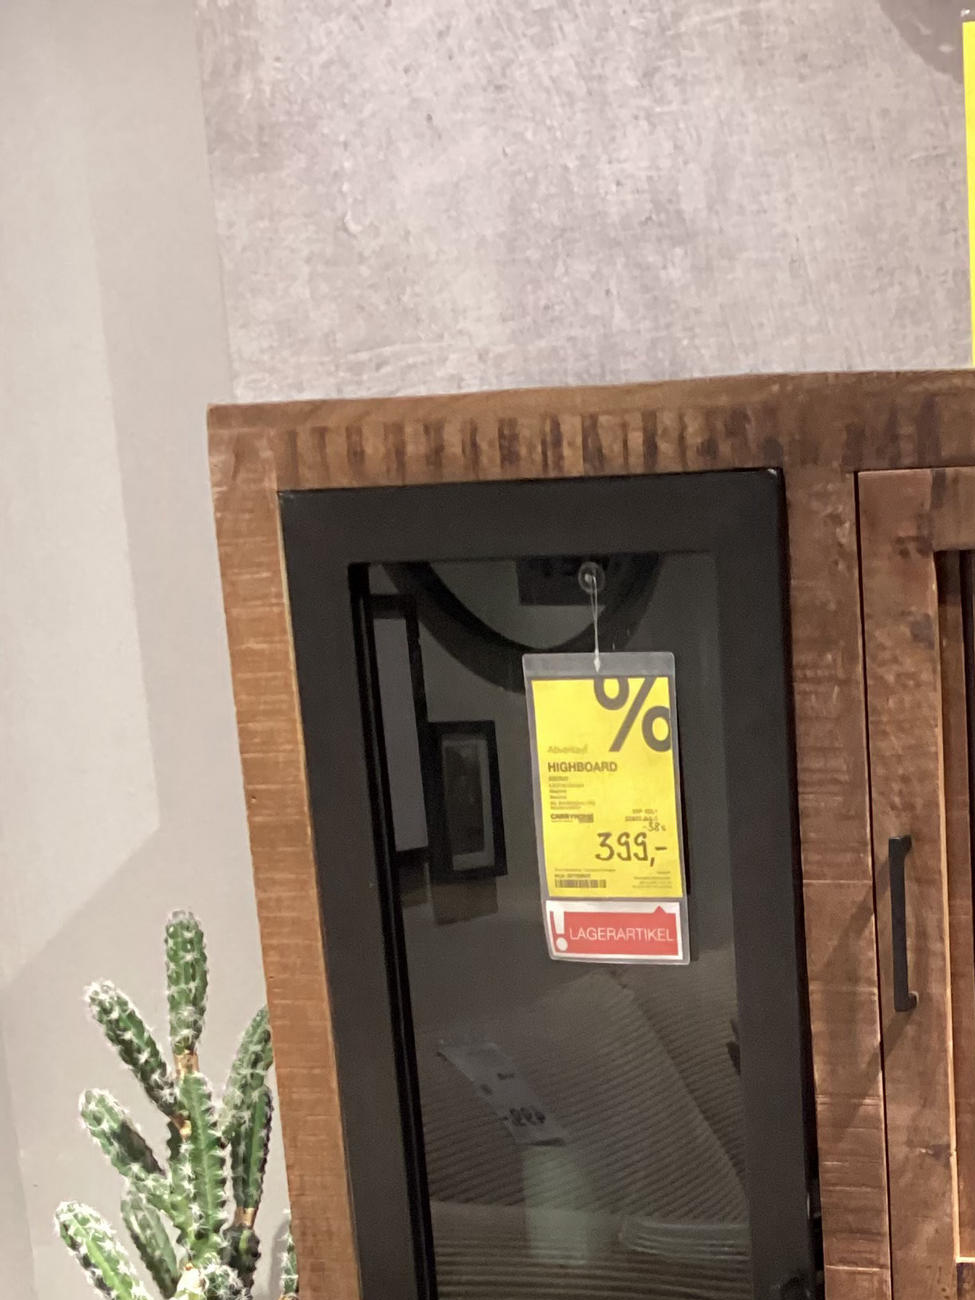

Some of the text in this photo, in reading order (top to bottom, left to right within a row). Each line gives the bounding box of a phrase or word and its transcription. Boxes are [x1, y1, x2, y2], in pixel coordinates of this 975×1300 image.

[547, 761, 618, 773] HIGHBOARD
[595, 831, 668, 867] 399,-
[569, 926, 674, 942] LAGERARTIKEL
